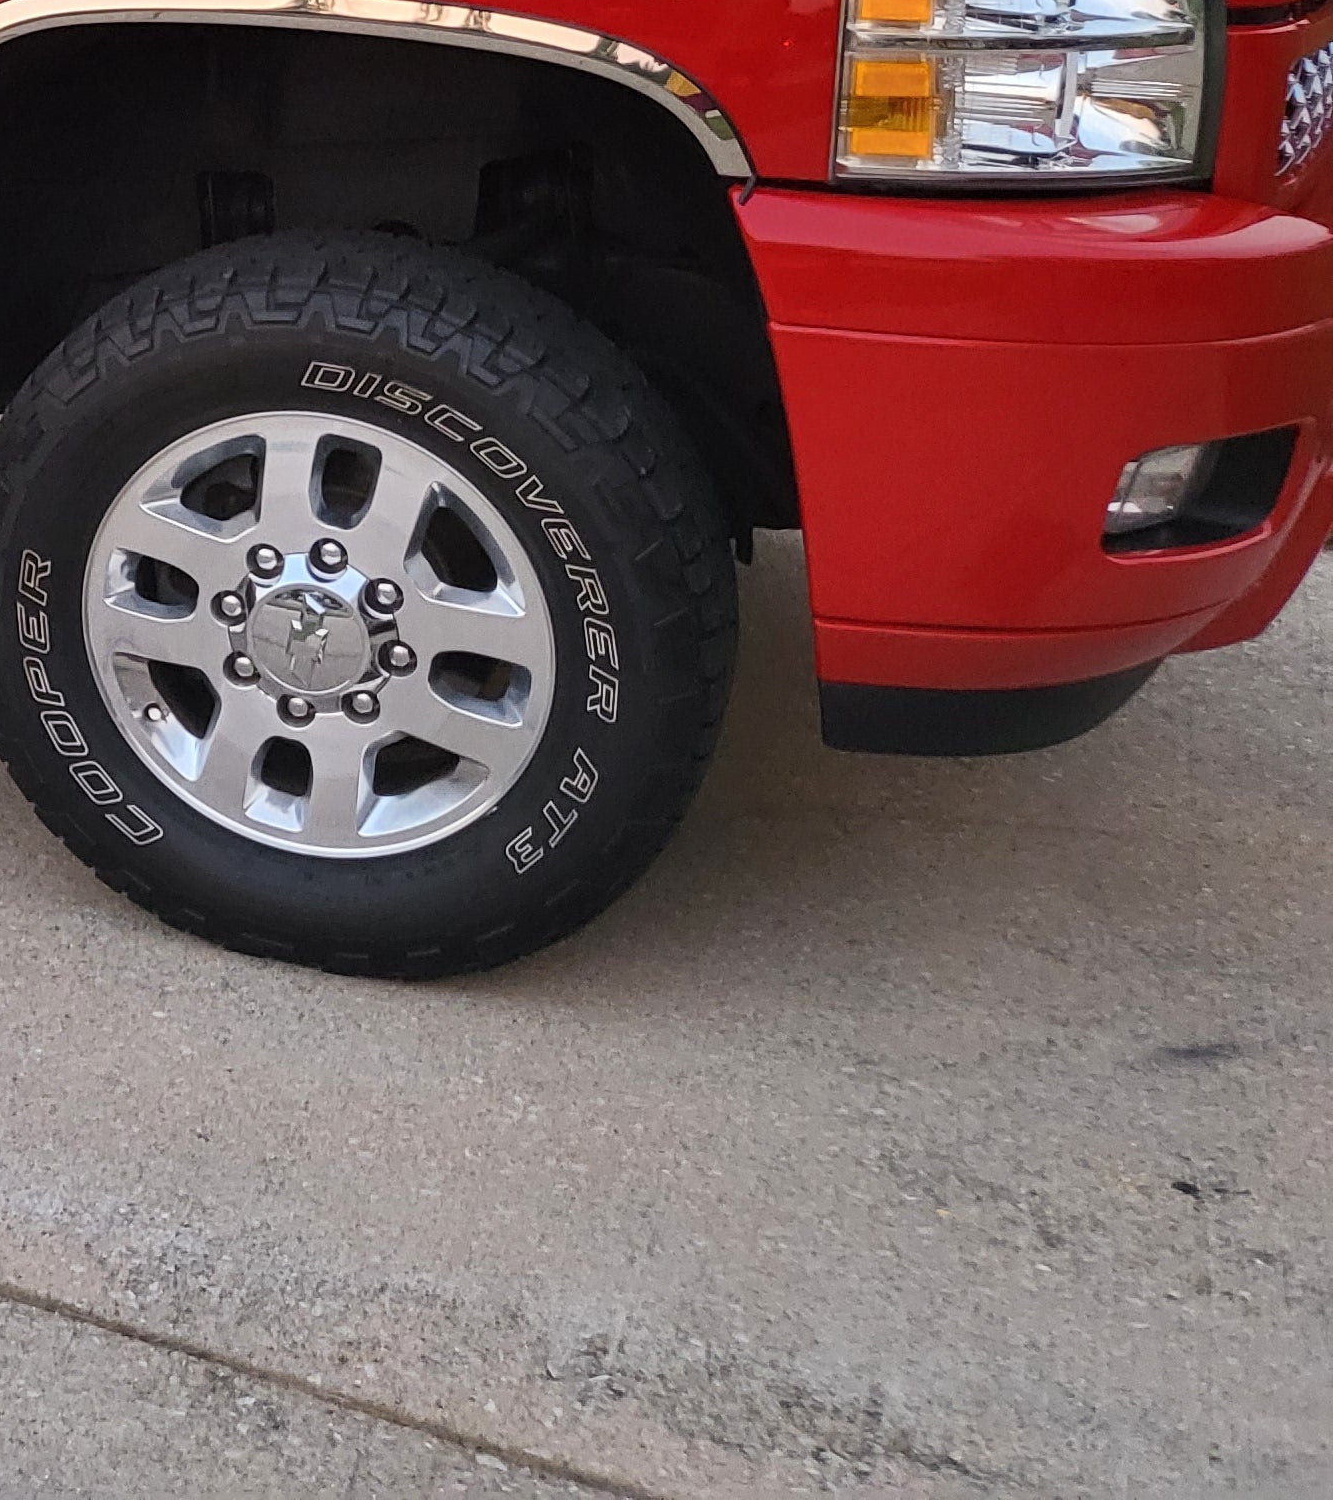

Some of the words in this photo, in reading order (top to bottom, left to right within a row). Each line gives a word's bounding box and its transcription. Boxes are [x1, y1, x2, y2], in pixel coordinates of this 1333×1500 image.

[17, 549, 164, 846] COOPER
[299, 360, 620, 723] DISCOVERER
[505, 747, 600, 875] AT3
